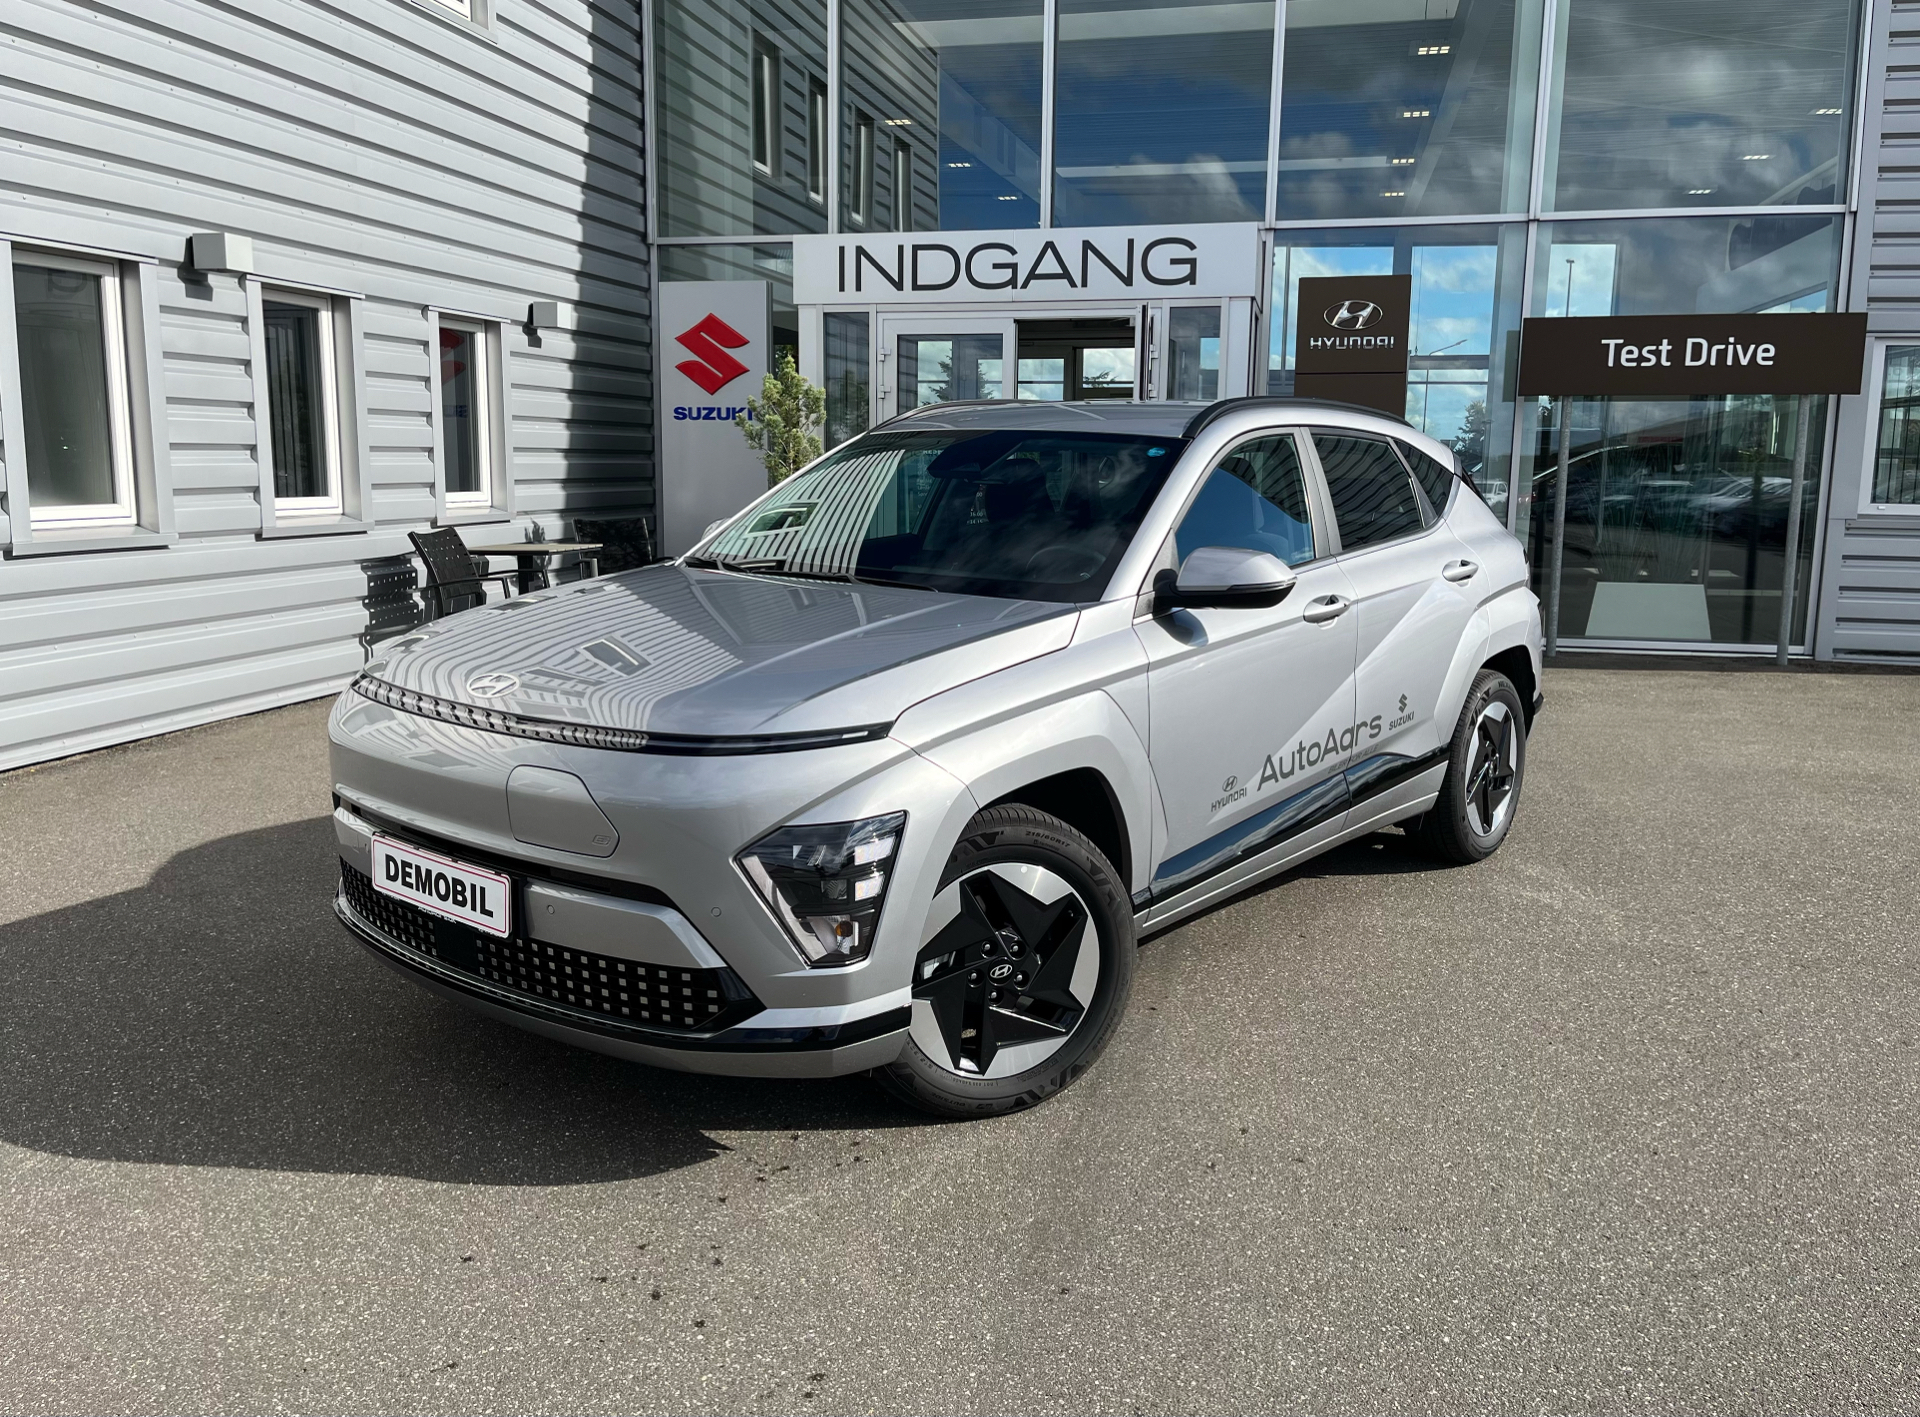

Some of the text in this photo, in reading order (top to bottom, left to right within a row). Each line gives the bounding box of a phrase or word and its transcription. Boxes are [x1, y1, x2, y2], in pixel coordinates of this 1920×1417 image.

[837, 237, 1198, 292] INDGANG
[1309, 336, 1395, 350] HYUNDAI
[1601, 336, 1776, 367] Test Drive
[673, 406, 753, 421] SUZUKI
[1388, 711, 1415, 731] SUZUKI
[1257, 714, 1383, 792] AutoAars
[1211, 787, 1247, 812] HYUNDAI
[384, 853, 494, 919] DEMOBIL
